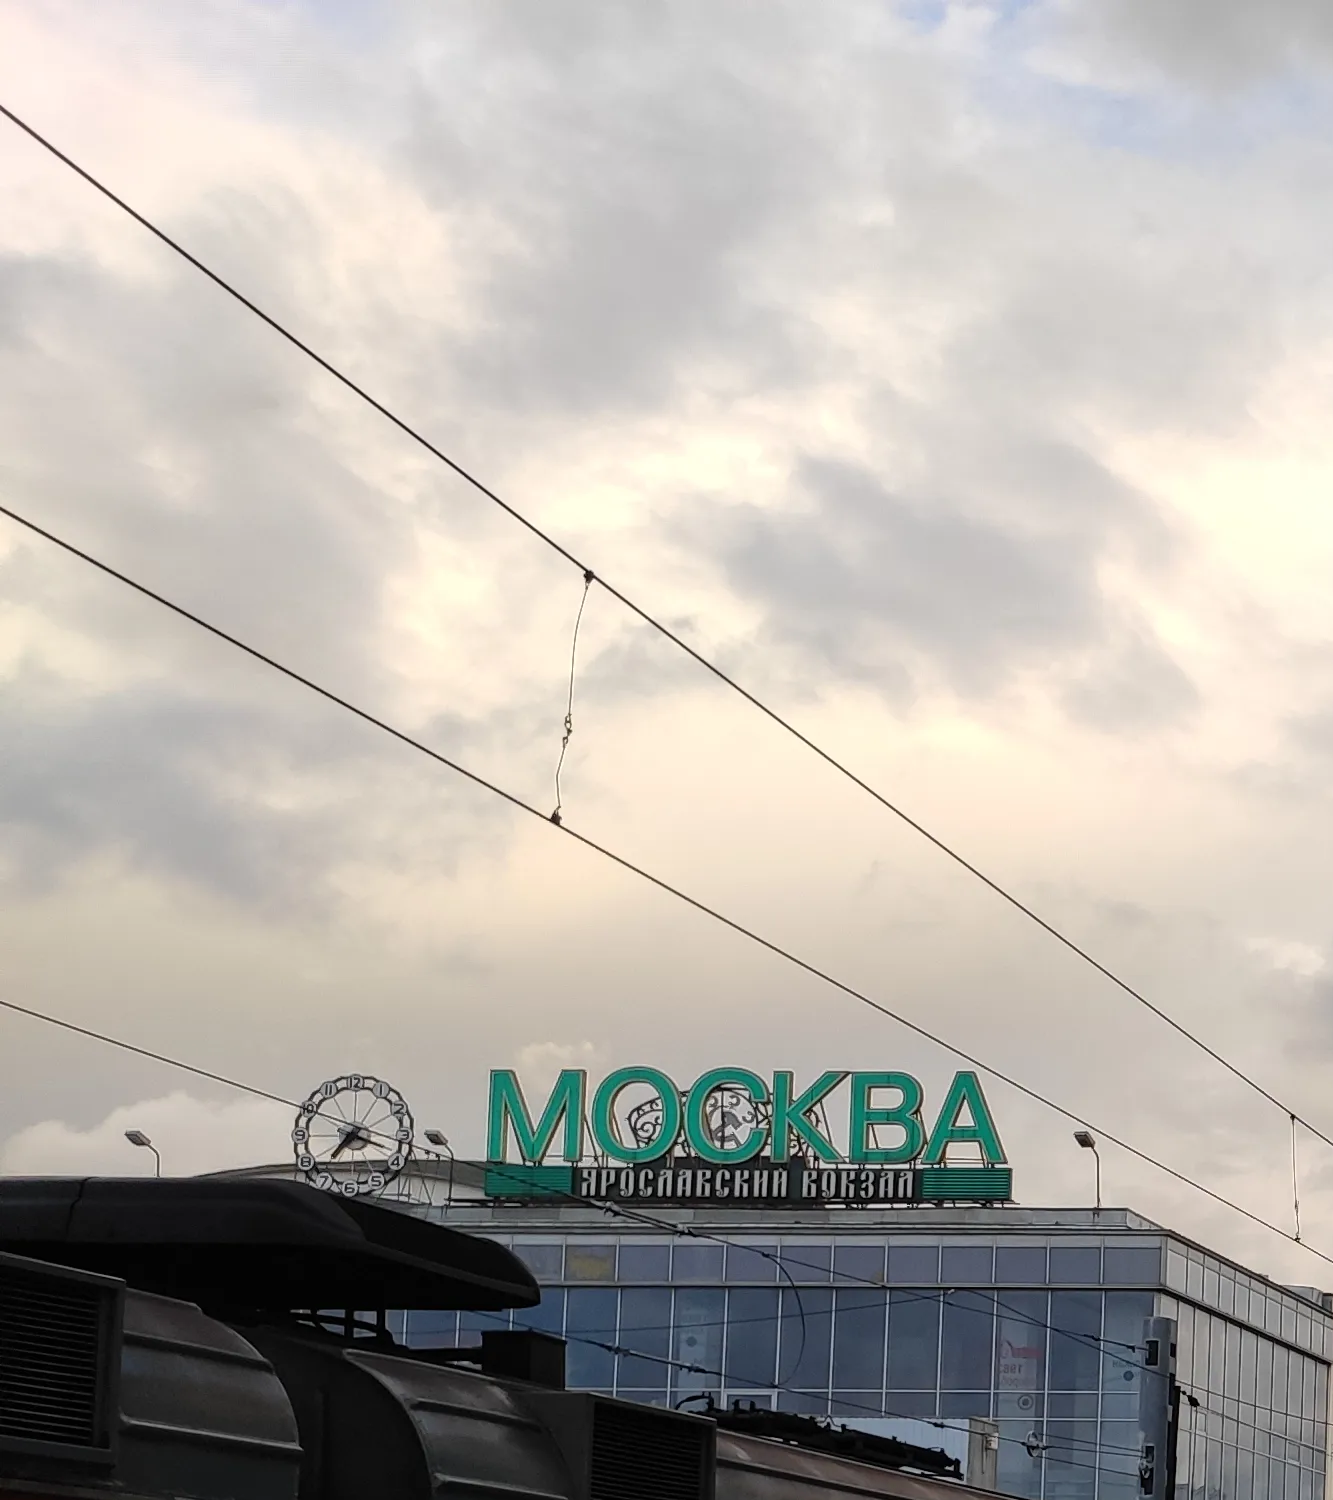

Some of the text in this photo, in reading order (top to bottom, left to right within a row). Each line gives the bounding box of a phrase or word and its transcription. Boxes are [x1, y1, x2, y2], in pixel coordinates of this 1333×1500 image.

[349, 1077, 362, 1089] 12
[325, 1084, 333, 1096] 11
[379, 1084, 383, 1096] 1
[393, 1103, 405, 1115] 2
[488, 1066, 1009, 1165] МОСКВА
[295, 1130, 305, 1140] 9
[400, 1130, 409, 1140] 3
[301, 1157, 311, 1167] 8
[390, 1157, 400, 1166] 4
[319, 1175, 329, 1188] 7
[371, 1176, 382, 1186] 5
[580, 1168, 914, 1198] ЯРОСЛАВСКИЙ ВОКЗАЛ
[344, 1183, 355, 1193] 6
